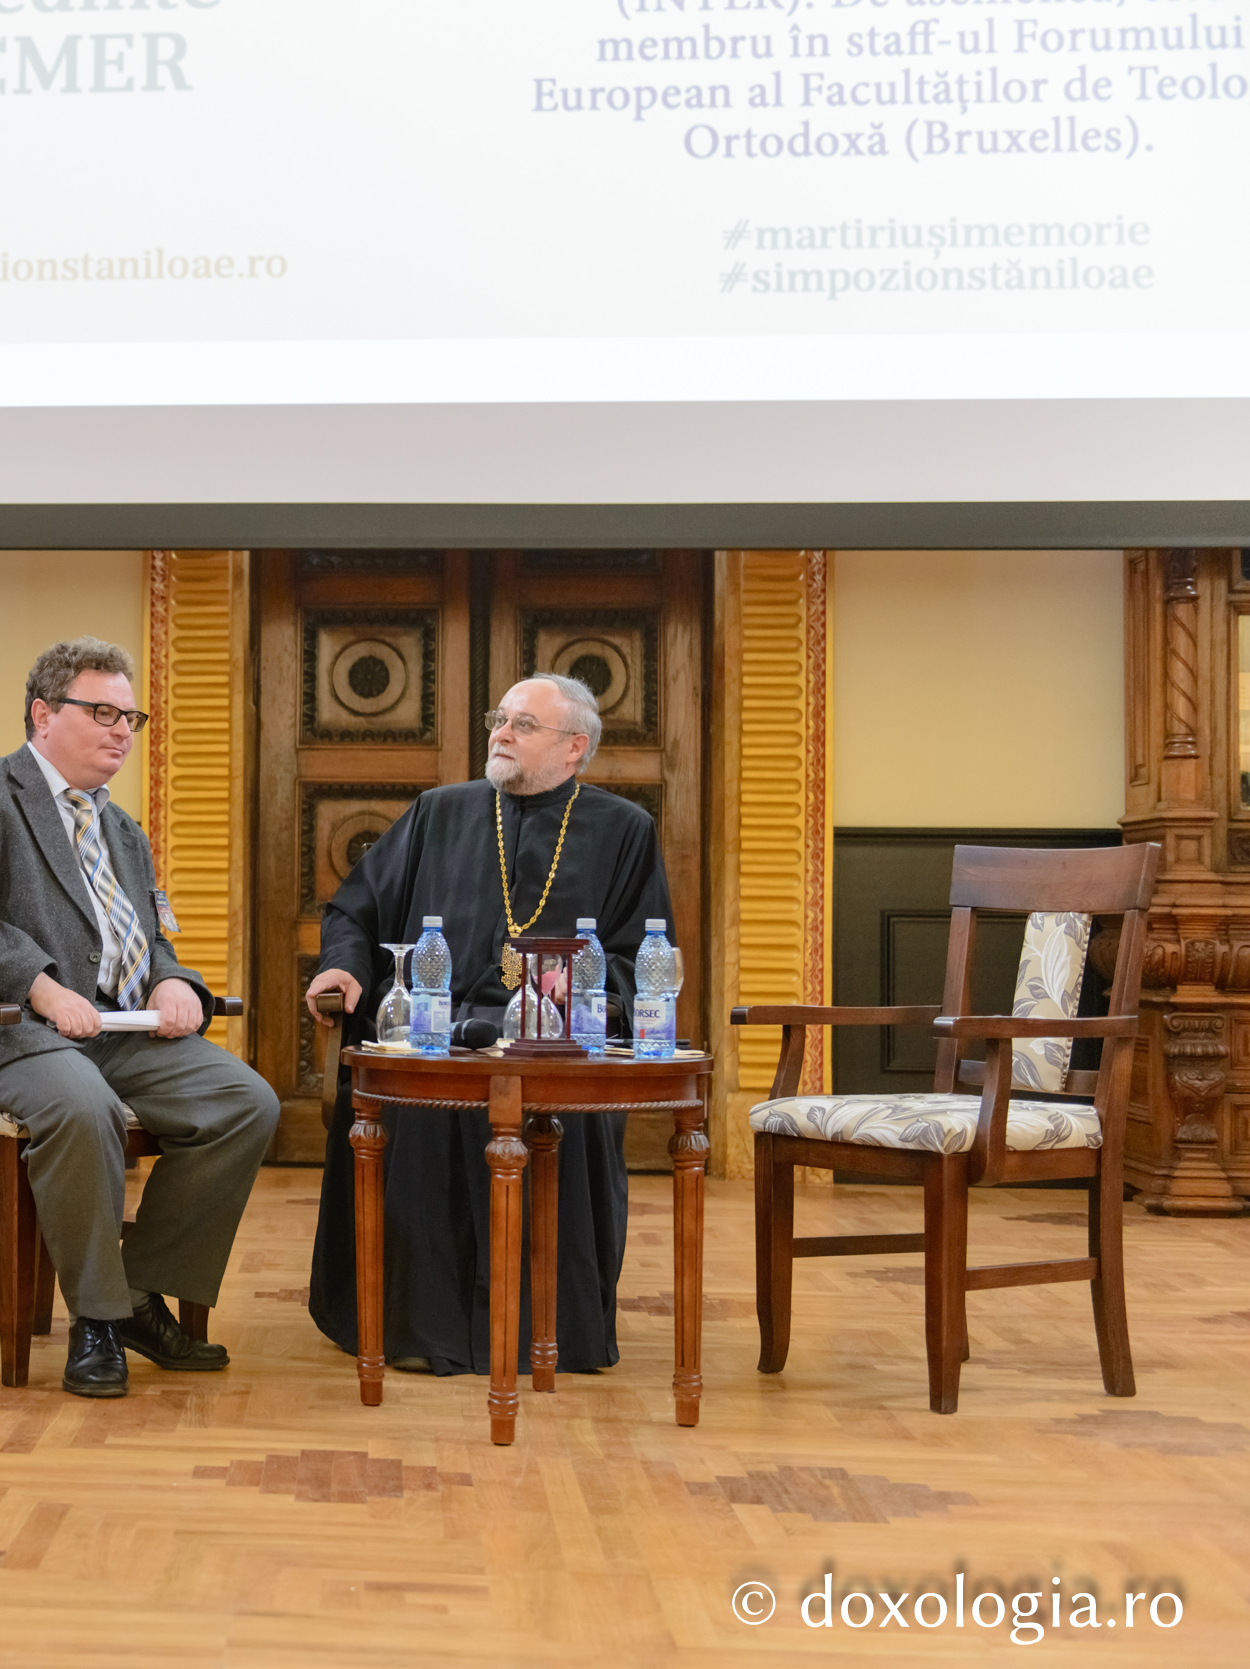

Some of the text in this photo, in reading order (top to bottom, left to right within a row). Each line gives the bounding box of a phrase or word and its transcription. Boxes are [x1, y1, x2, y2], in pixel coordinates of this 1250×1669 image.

[596, 12, 1246, 63] membru în staff-ul Forumului
[531, 61, 1250, 122] European al Facultăților de Teolo
[683, 114, 1154, 164] Ortodoxă (Bruxelles).
[722, 215, 1150, 261] #martiriușimemorie
[718, 257, 1154, 301] #simpozionstăniloae
